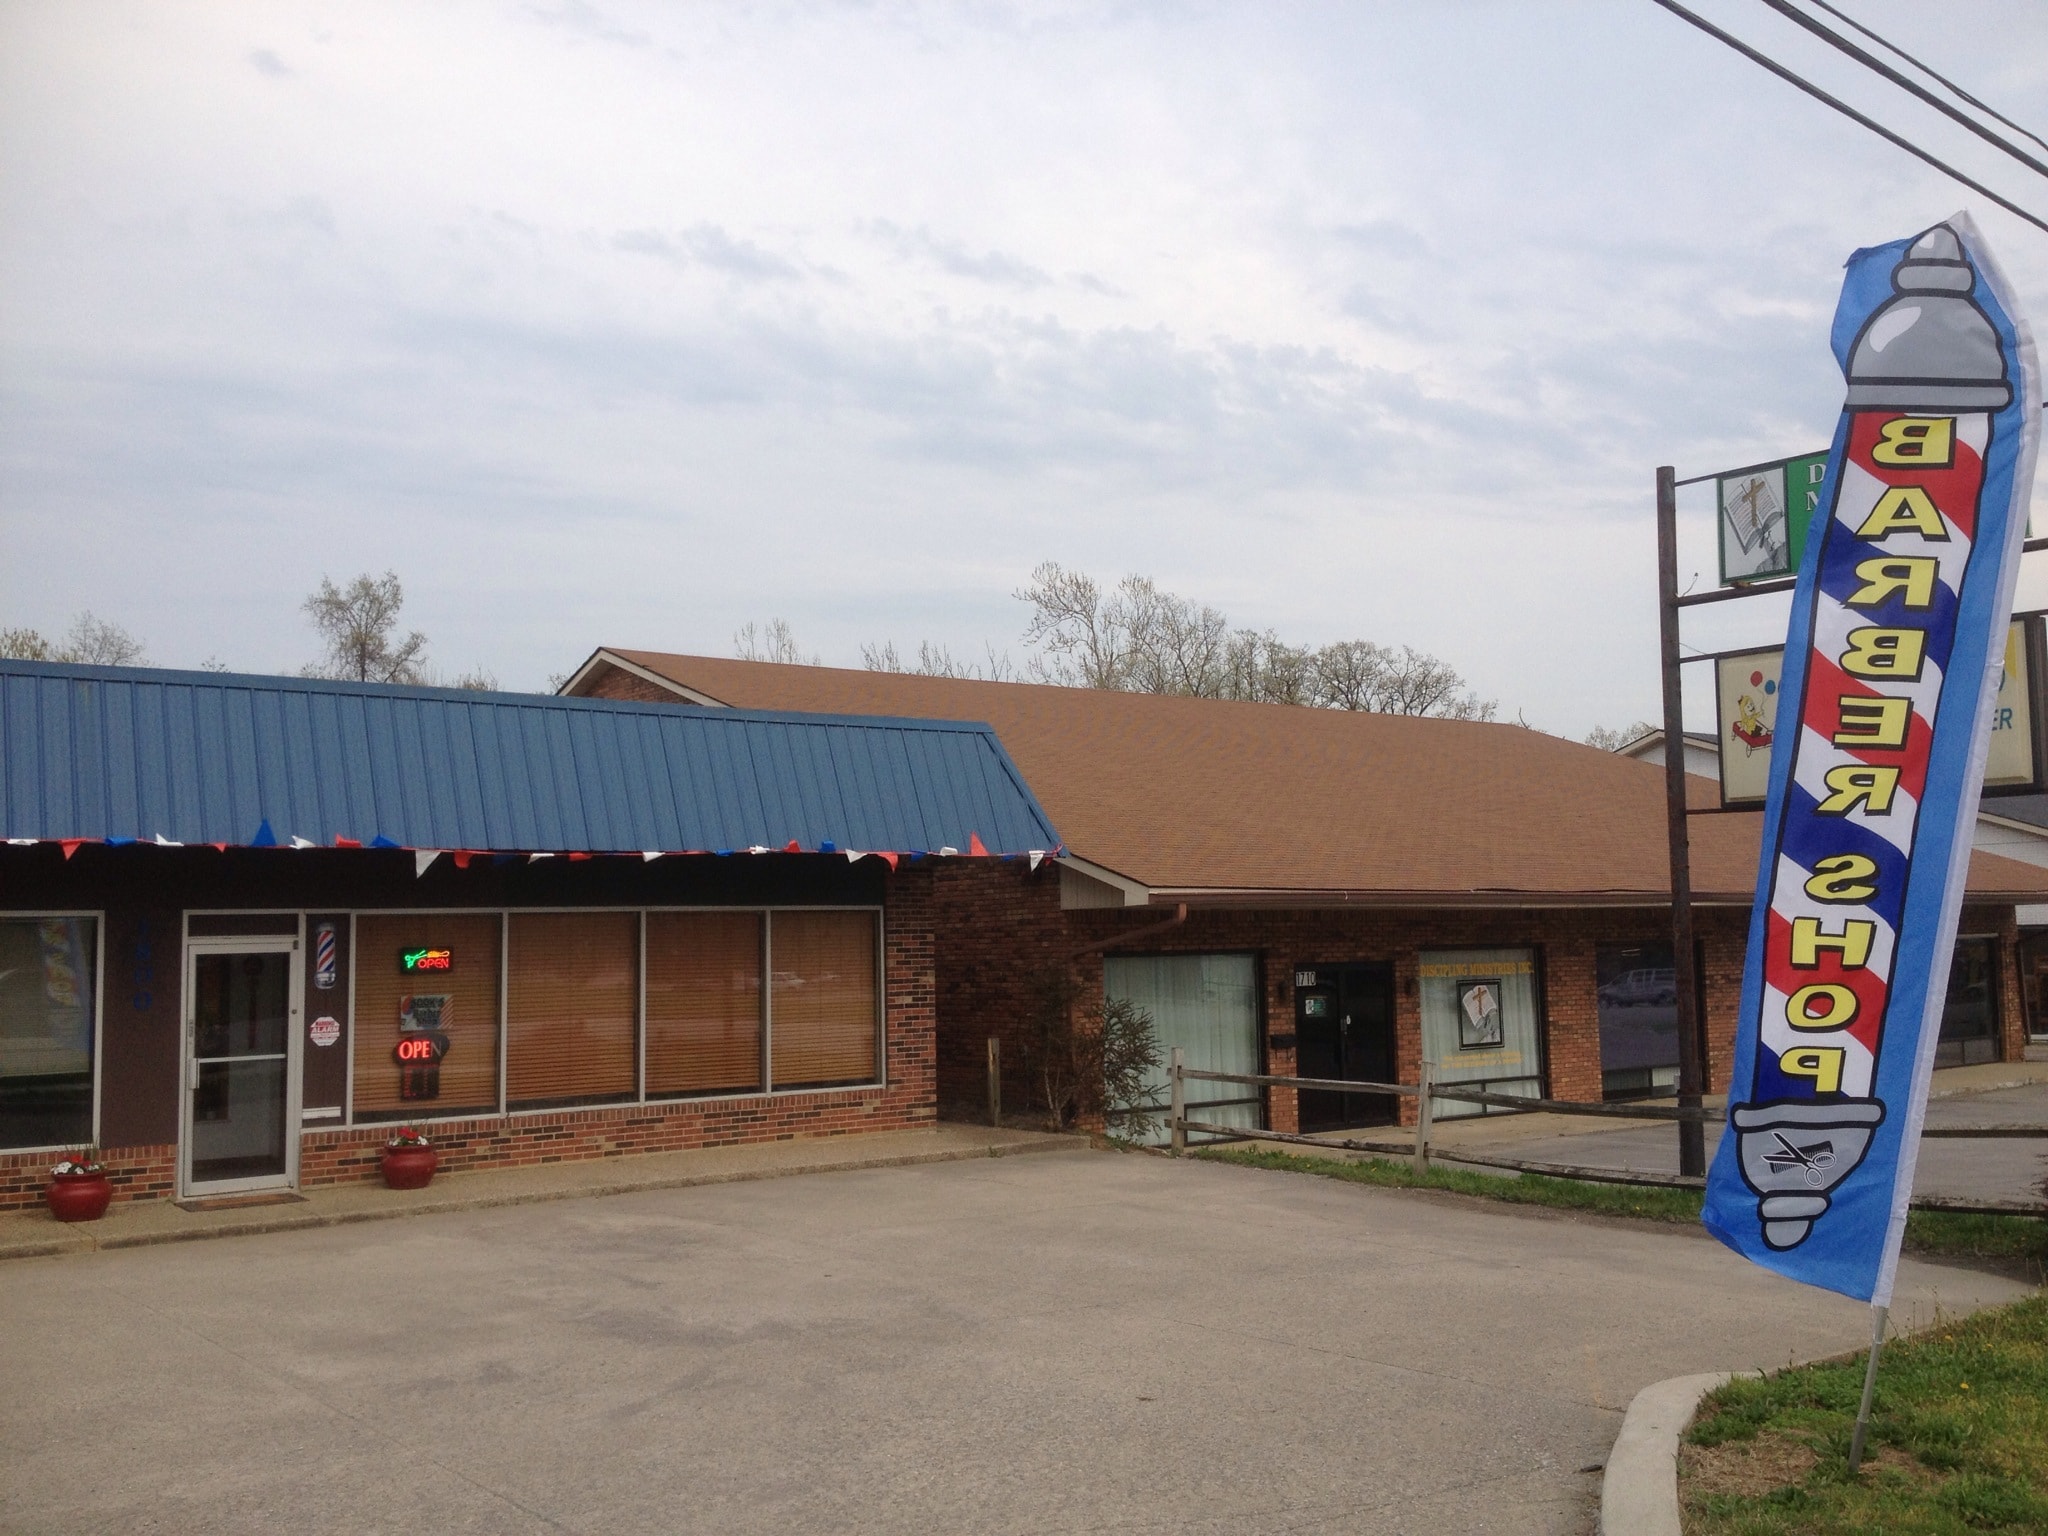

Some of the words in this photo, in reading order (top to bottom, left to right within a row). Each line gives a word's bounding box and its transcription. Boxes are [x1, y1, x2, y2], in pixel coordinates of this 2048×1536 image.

[418, 958, 449, 968] OPEN
[1297, 971, 1317, 986] 1710
[311, 1026, 340, 1034] ALARM
[399, 1041, 442, 1060] OPEN
